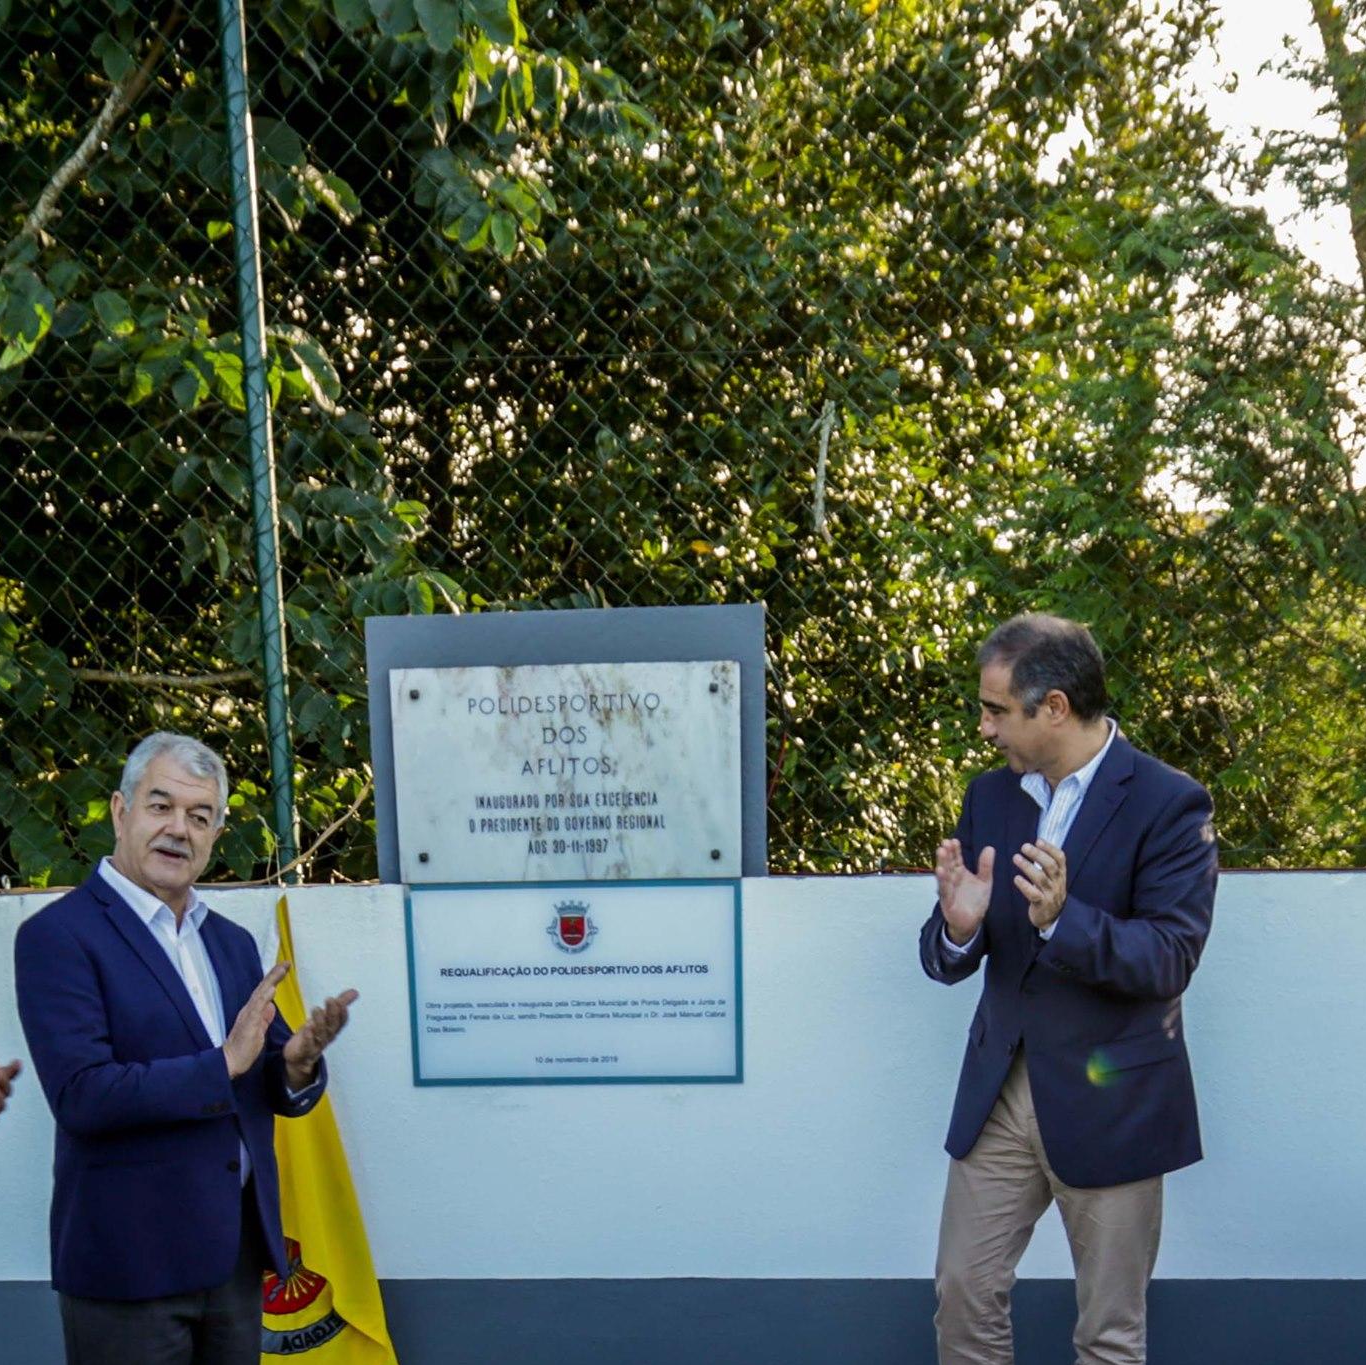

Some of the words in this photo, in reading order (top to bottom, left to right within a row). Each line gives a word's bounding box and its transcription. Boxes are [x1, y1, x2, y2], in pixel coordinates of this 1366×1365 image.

[467, 692, 661, 715] POLIDESPORTIVO
[542, 726, 588, 745] DOS
[521, 756, 612, 776] AFLITOS
[475, 794, 540, 809] INAUGURADO
[545, 794, 565, 808] POR
[569, 793, 590, 808] SUA
[468, 819, 476, 833] O
[480, 817, 542, 832] PRESIDENTE
[547, 816, 560, 831] DO
[565, 815, 612, 831] GOVERNO
[616, 815, 666, 829] REGIONAL
[528, 840, 547, 855] AOS
[553, 838, 609, 853] 30-11-1997
[440, 966, 531, 977] REQUALIFICAÇÃO
[533, 966, 549, 976] DO
[550, 965, 640, 976] POLIDESPORTIVO
[641, 965, 663, 975] DOS
[665, 964, 709, 974] AFLITOS
